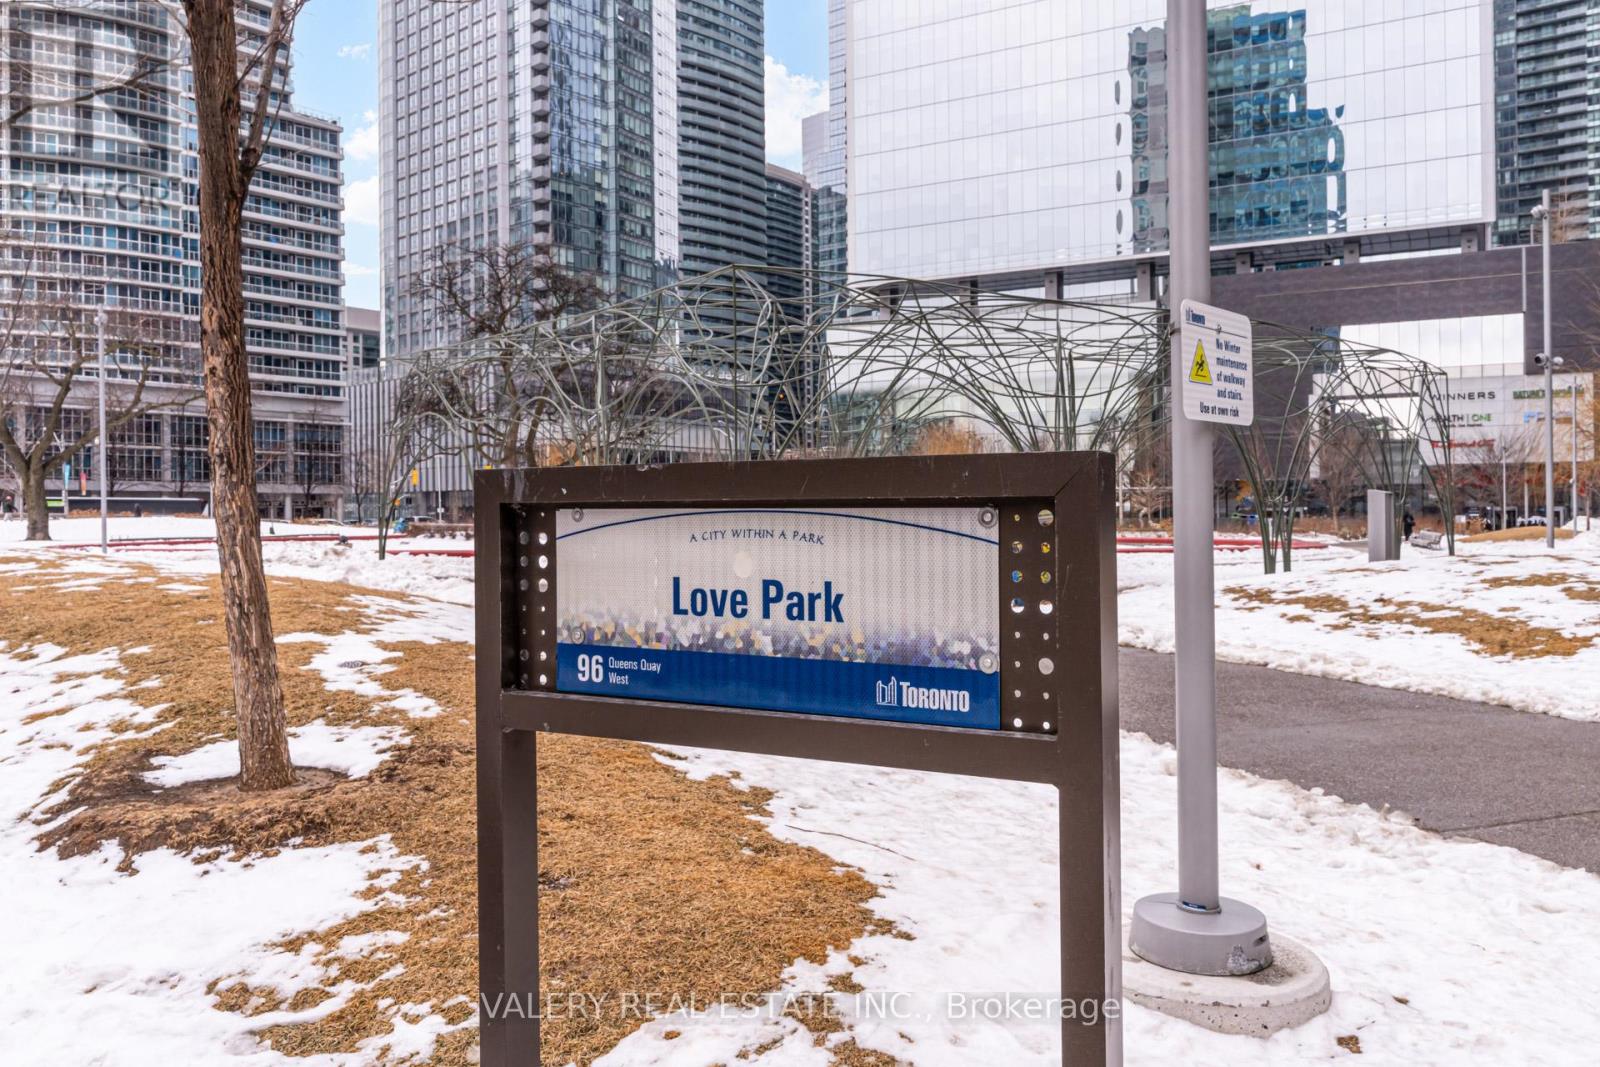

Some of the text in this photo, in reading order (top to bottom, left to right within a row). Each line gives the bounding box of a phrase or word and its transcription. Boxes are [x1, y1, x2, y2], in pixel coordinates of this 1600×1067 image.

[1216, 339, 1241, 354] No Winter
[1216, 357, 1248, 371] maintenance
[1217, 371, 1245, 388] of walkway
[1217, 389, 1227, 399] and
[1200, 402, 1239, 417] Use at own risk
[690, 529, 825, 545] A CITY WITHIN A PARK
[673, 577, 845, 623] Love Park
[577, 654, 661, 683] 96 Queens Quay
[608, 672, 629, 685] West
[900, 681, 970, 713] TORONTO
